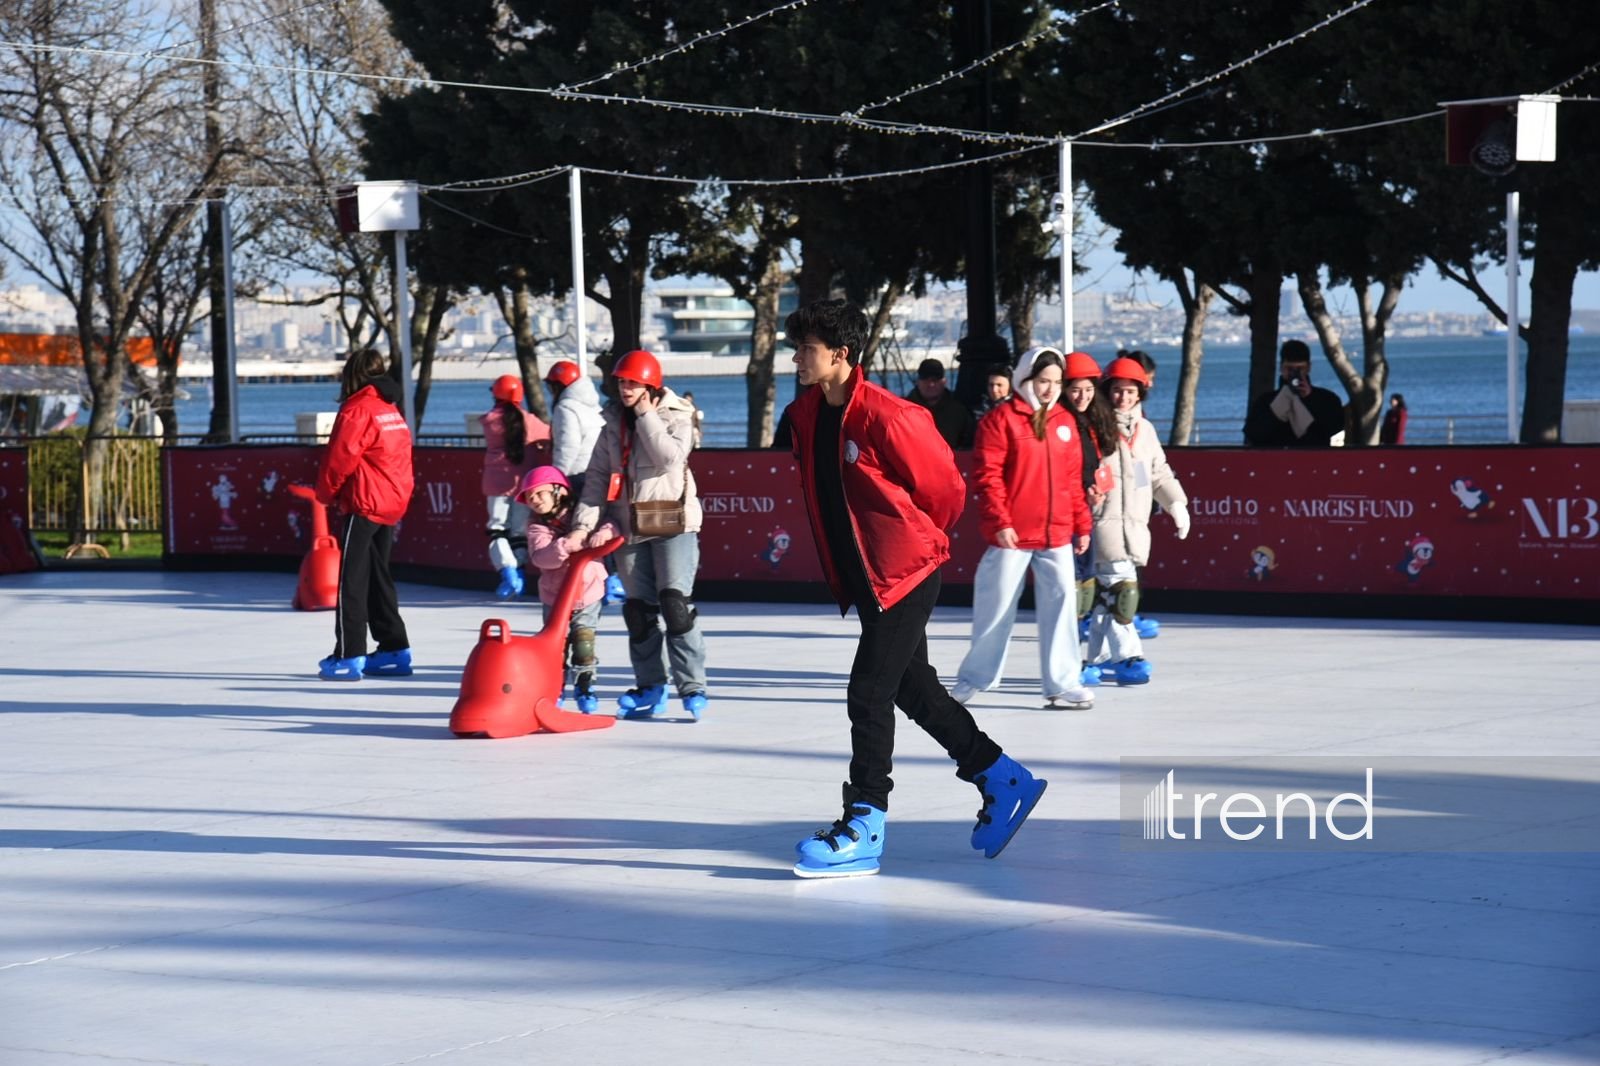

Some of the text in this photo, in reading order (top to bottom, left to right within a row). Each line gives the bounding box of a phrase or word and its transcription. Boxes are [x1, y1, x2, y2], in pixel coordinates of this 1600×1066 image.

[702, 496, 775, 512] GIS FUND
[1191, 495, 1259, 515] tudio
[1283, 499, 1414, 518] NARGIS FUND
